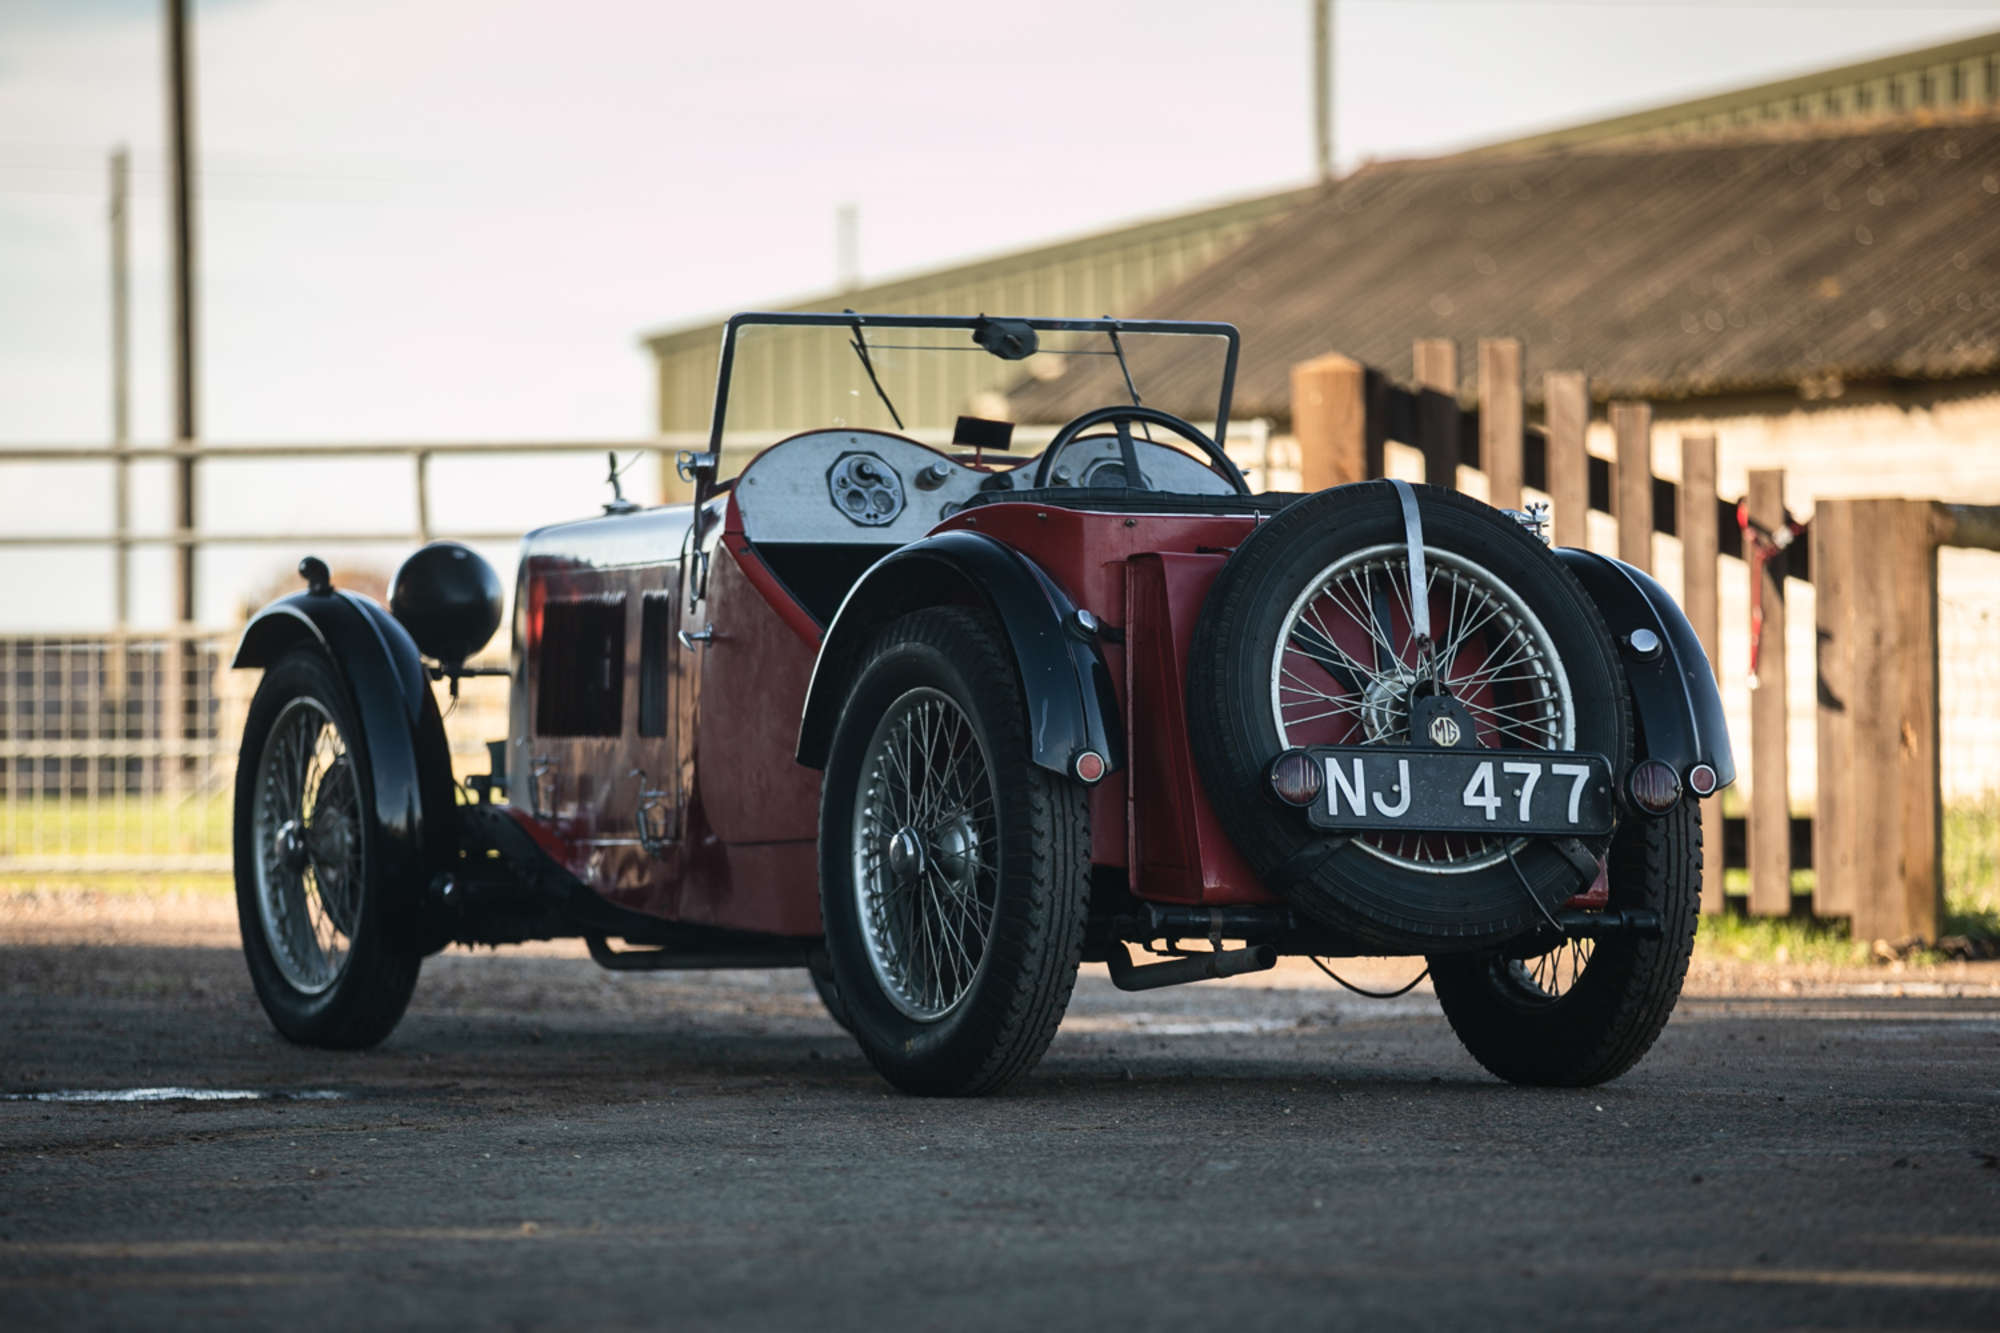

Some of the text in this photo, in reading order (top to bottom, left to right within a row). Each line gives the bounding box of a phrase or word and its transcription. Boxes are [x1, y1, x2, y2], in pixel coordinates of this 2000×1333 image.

[1433, 718, 1459, 745] MG
[1324, 757, 1590, 824] NJ 477
